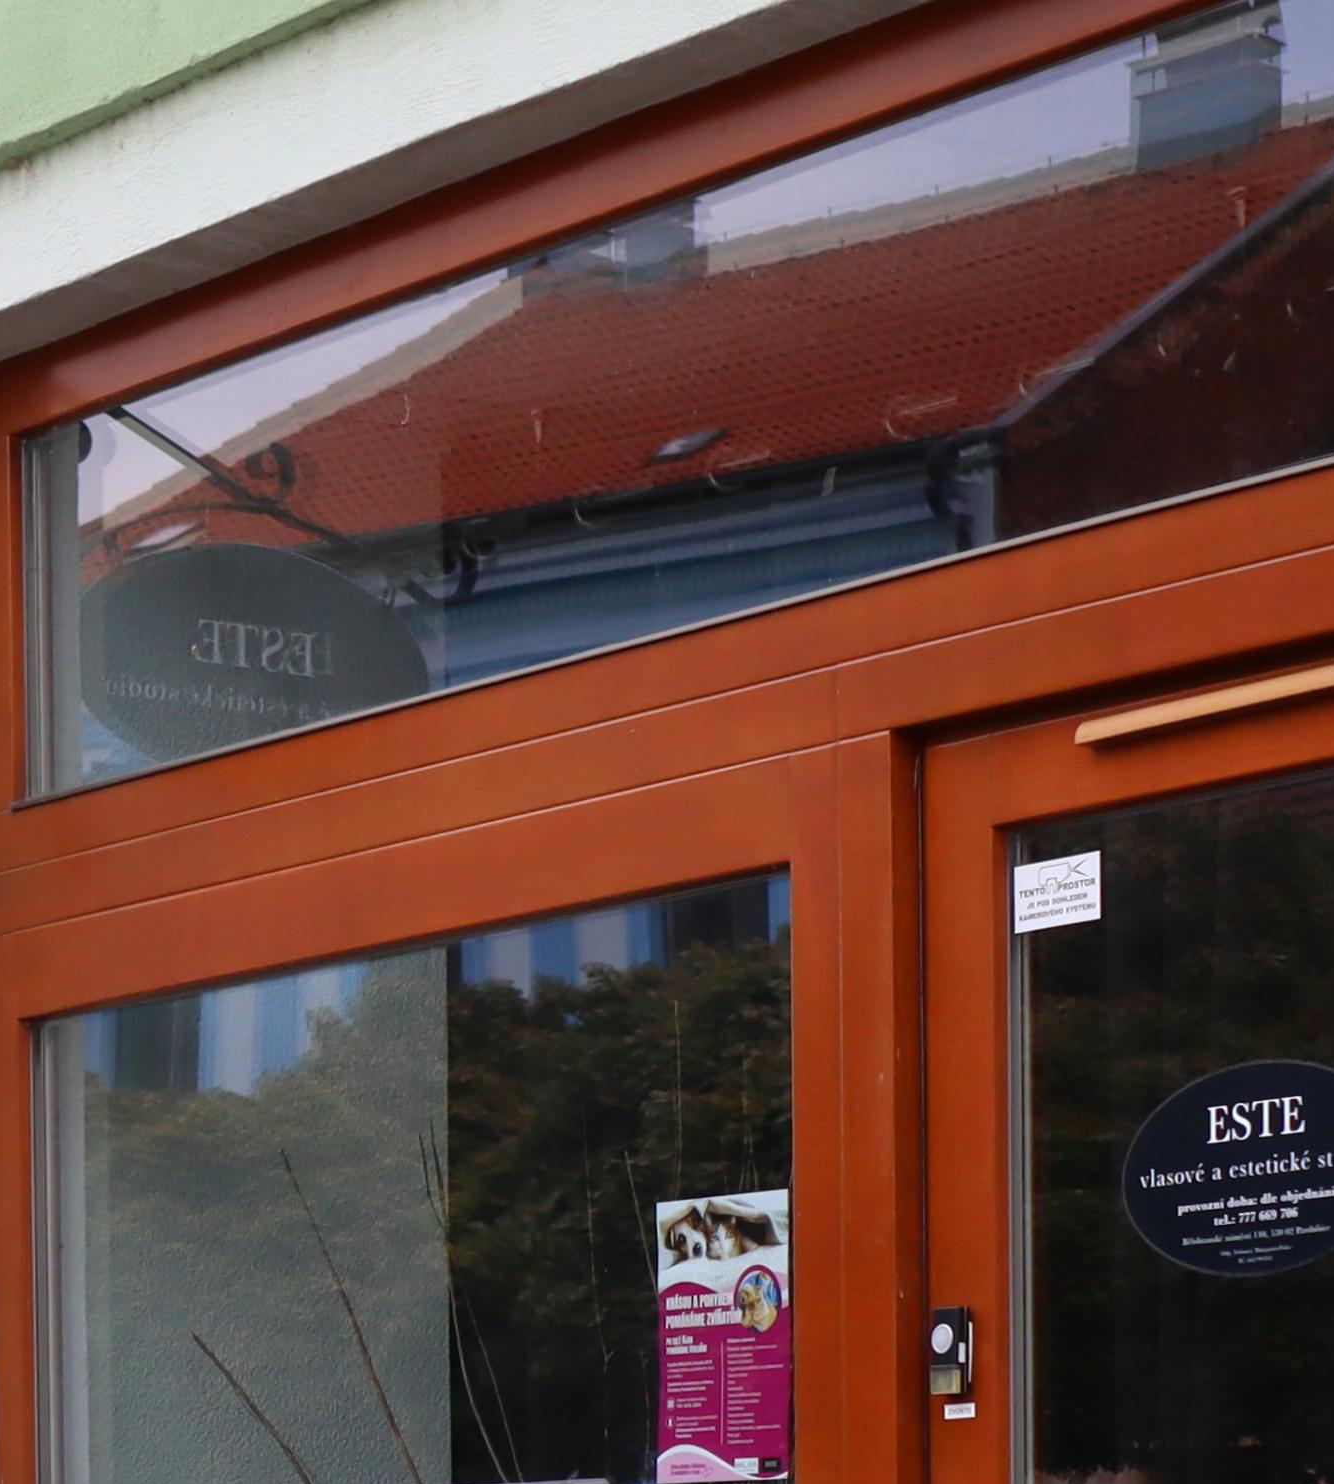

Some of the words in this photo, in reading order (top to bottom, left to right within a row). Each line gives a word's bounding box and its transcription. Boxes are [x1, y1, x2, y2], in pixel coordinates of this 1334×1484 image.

[1019, 887, 1046, 899] TENTO
[1057, 878, 1096, 892] PROSTOR
[1206, 1095, 1306, 1144] ESTE
[1139, 1163, 1205, 1189] vlasové
[1212, 1166, 1222, 1180] a
[1229, 1151, 1311, 1179] estetické
[1227, 1195, 1258, 1209] doba:
[1260, 1192, 1278, 1205] dle
[1238, 1211, 1257, 1224] 777
